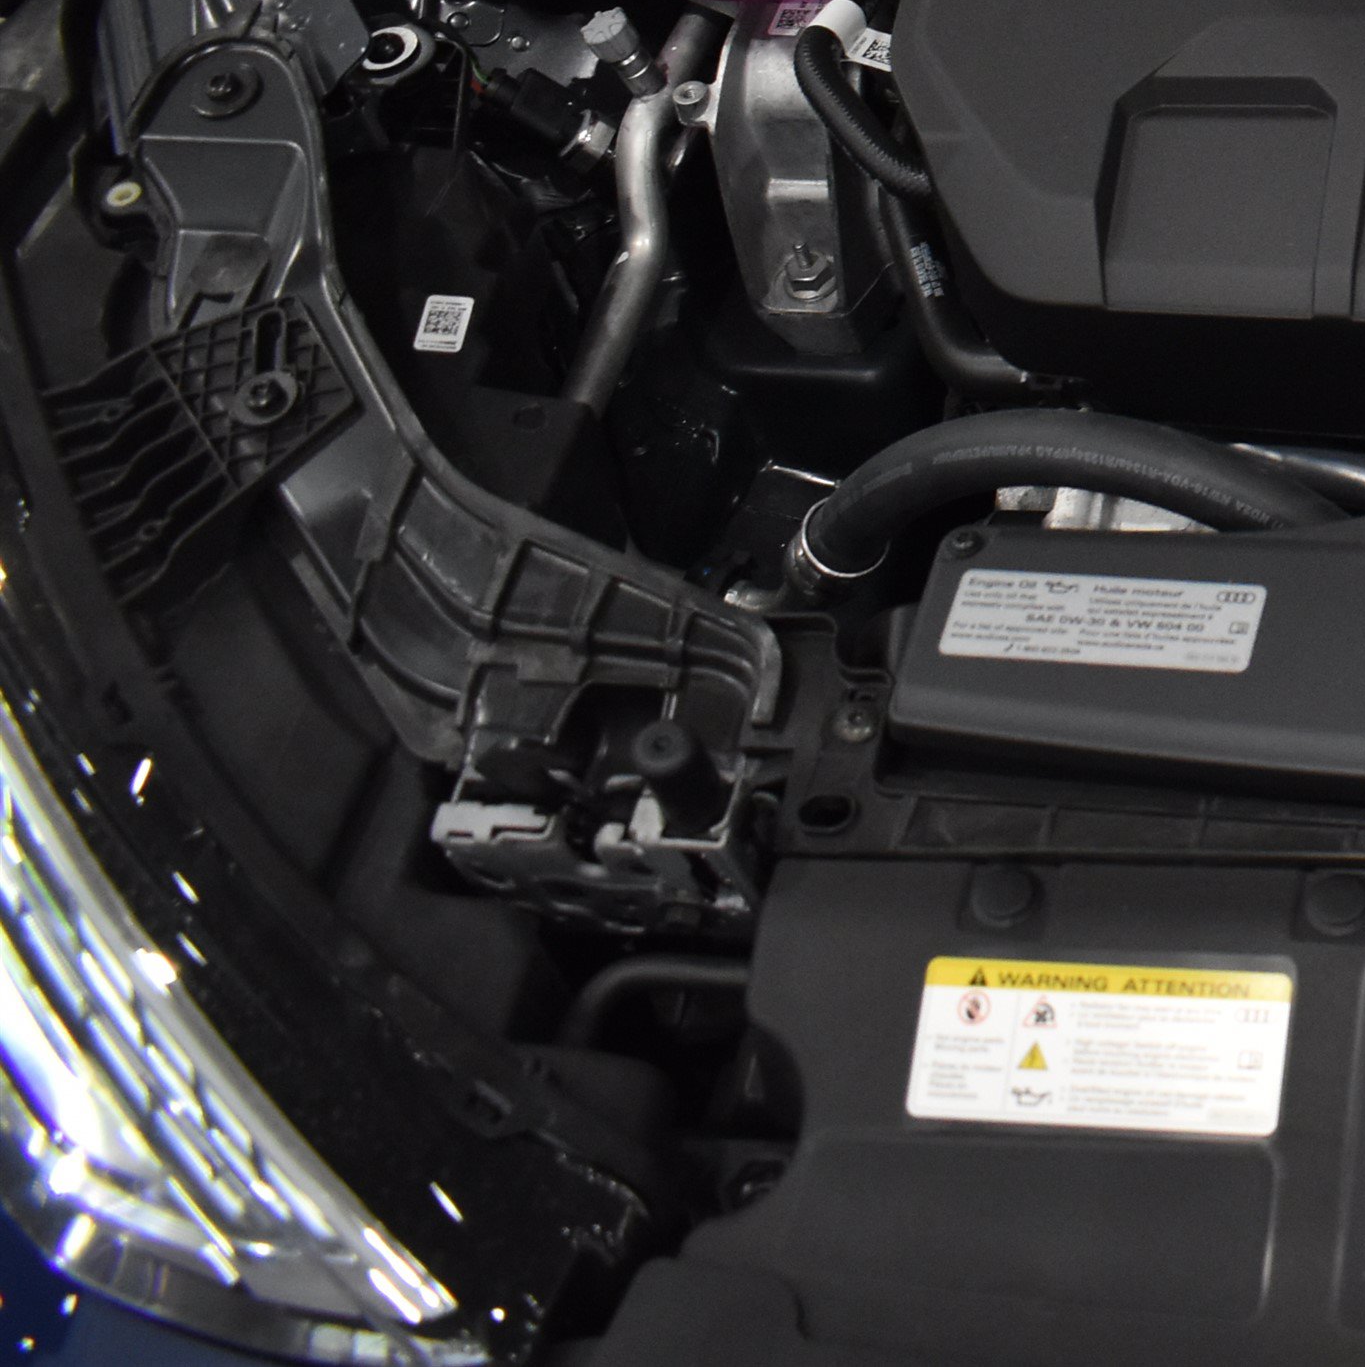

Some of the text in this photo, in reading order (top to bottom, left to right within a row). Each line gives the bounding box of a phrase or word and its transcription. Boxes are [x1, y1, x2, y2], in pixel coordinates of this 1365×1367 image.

[969, 578, 1014, 588] Engine
[1093, 584, 1184, 597] Huile moteur
[1026, 613, 1055, 623] SAE
[1109, 619, 1120, 628] &
[1127, 620, 1152, 629] VW
[1187, 623, 1205, 632] 00
[998, 970, 1251, 999] WARNING ATTENTION
